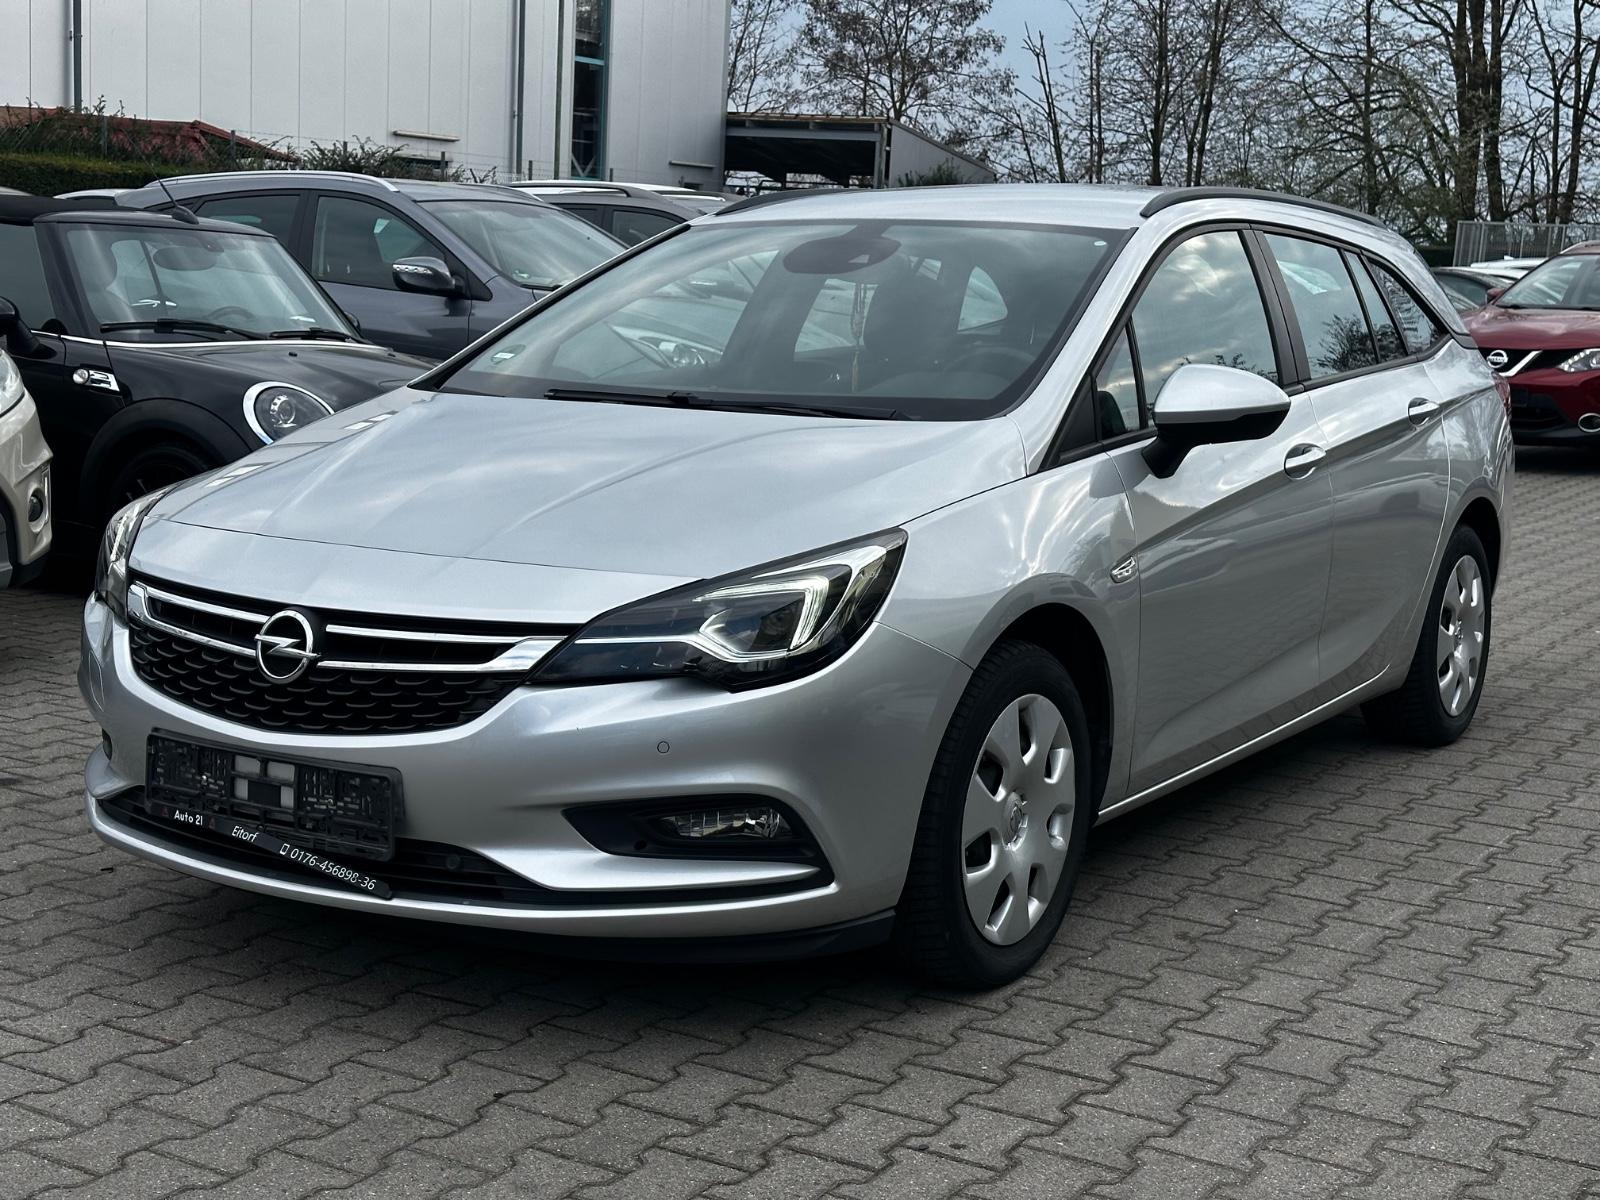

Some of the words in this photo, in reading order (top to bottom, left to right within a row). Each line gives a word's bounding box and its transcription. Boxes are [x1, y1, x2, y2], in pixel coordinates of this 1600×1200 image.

[174, 809, 194, 823] Auto
[195, 814, 203, 826] 21
[231, 825, 259, 842] Eitorf
[290, 848, 377, 890] 0176-456898-36
